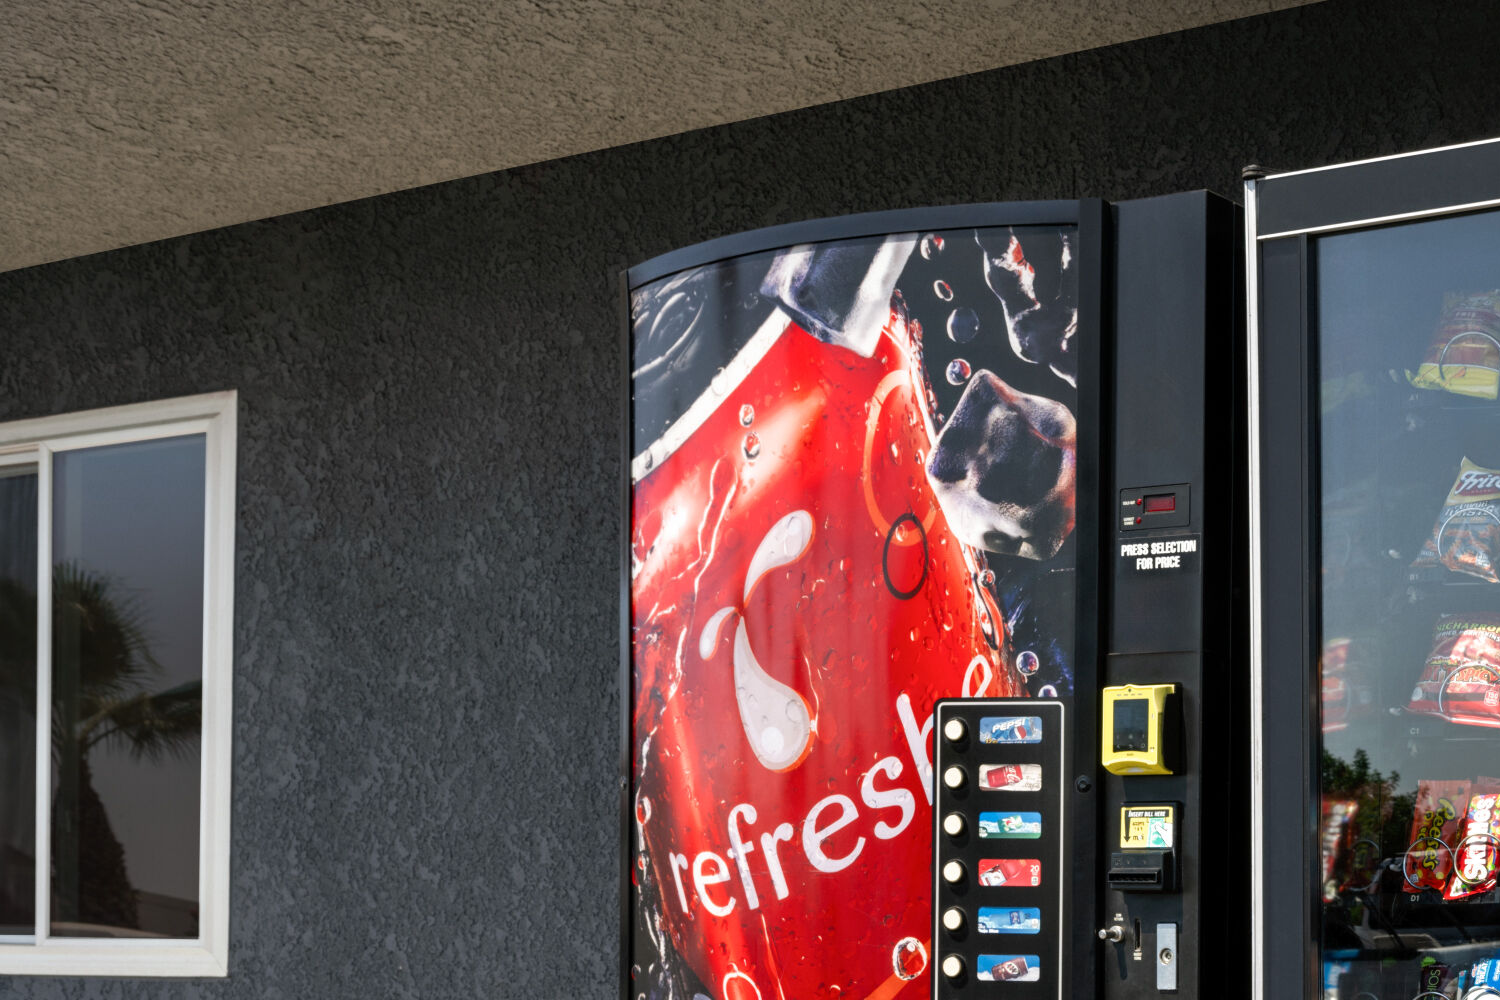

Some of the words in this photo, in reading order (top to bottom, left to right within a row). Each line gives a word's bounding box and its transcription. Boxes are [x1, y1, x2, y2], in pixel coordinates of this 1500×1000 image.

[1121, 543, 1149, 557] PRESS
[1151, 539, 1197, 555] SELECTION
[1136, 558, 1153, 570] FOR
[1155, 556, 1181, 569] PRICE
[992, 718, 1026, 733] PEPSI
[1030, 864, 1040, 873] 20
